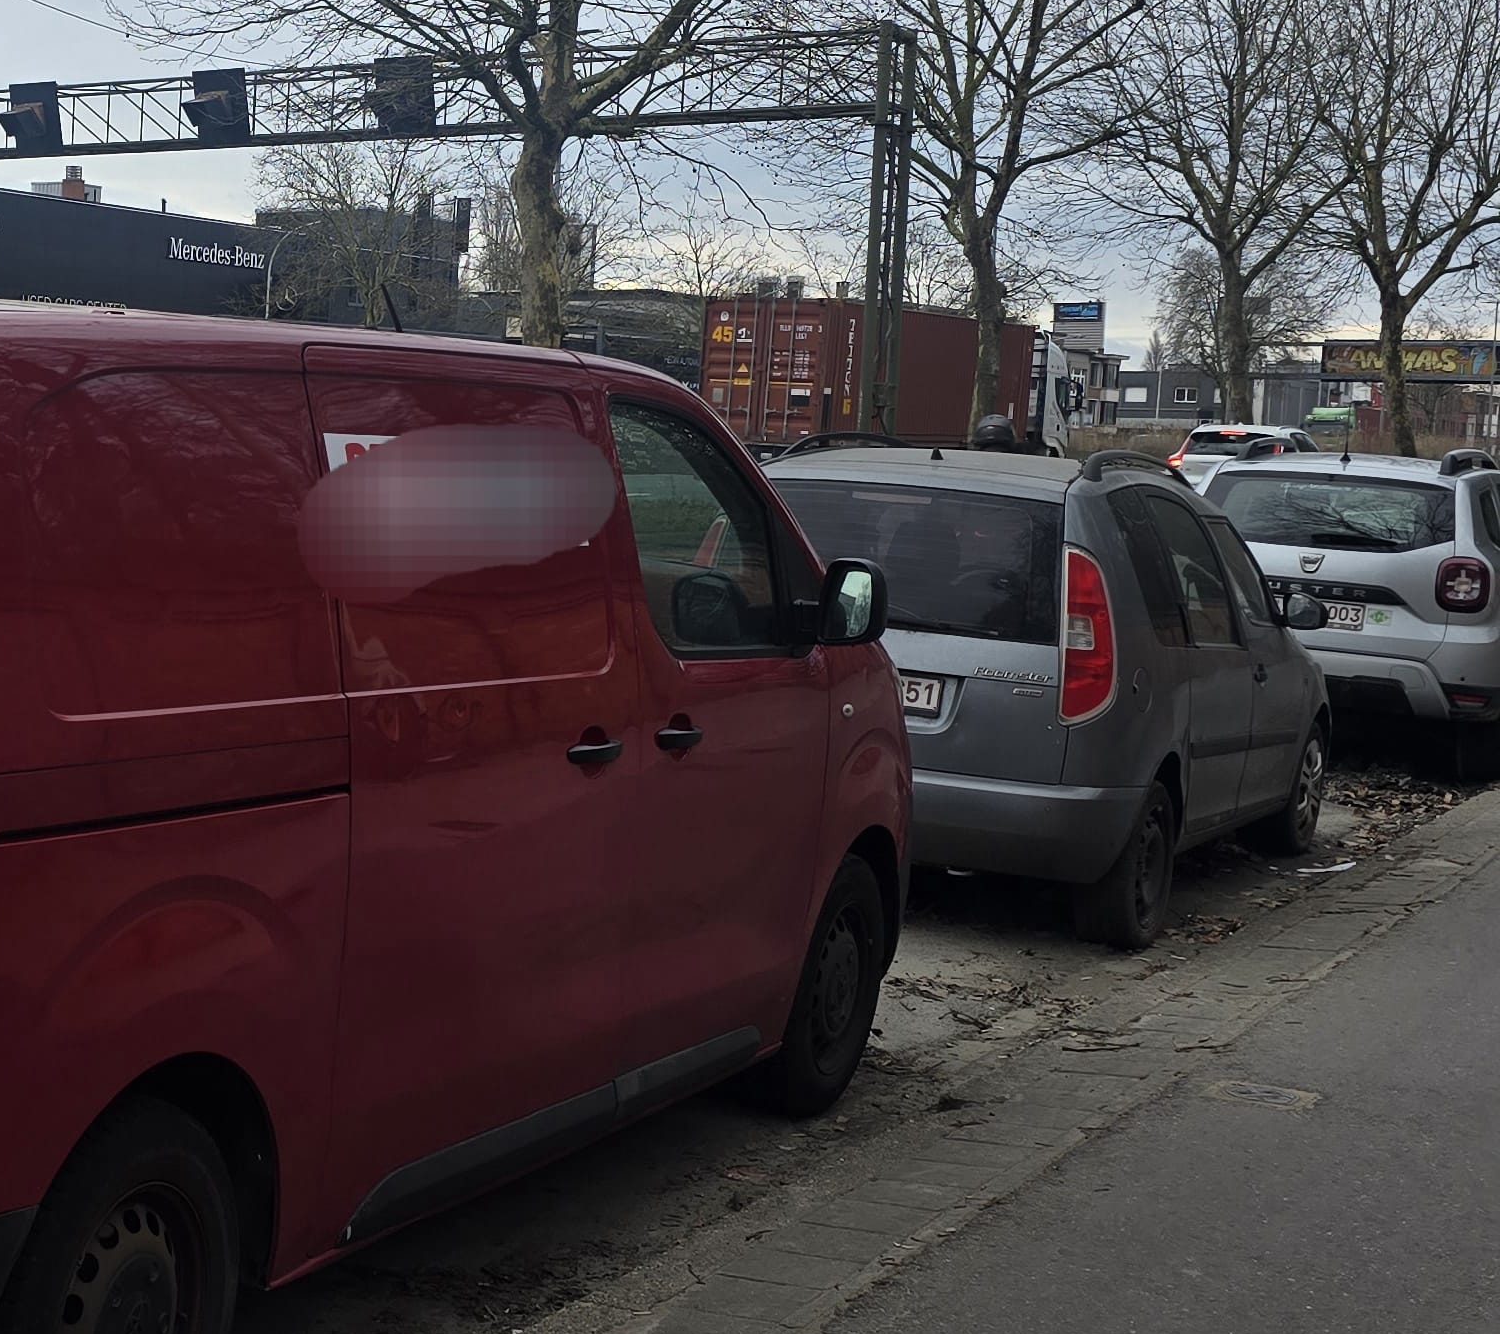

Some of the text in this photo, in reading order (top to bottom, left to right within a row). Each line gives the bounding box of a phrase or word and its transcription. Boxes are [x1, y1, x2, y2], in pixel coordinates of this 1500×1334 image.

[169, 237, 266, 269] Mercedes-Benz
[712, 325, 733, 343] 45
[1267, 581, 1367, 598] USTER
[973, 666, 1051, 683] Roomster
[902, 680, 935, 705] 51
